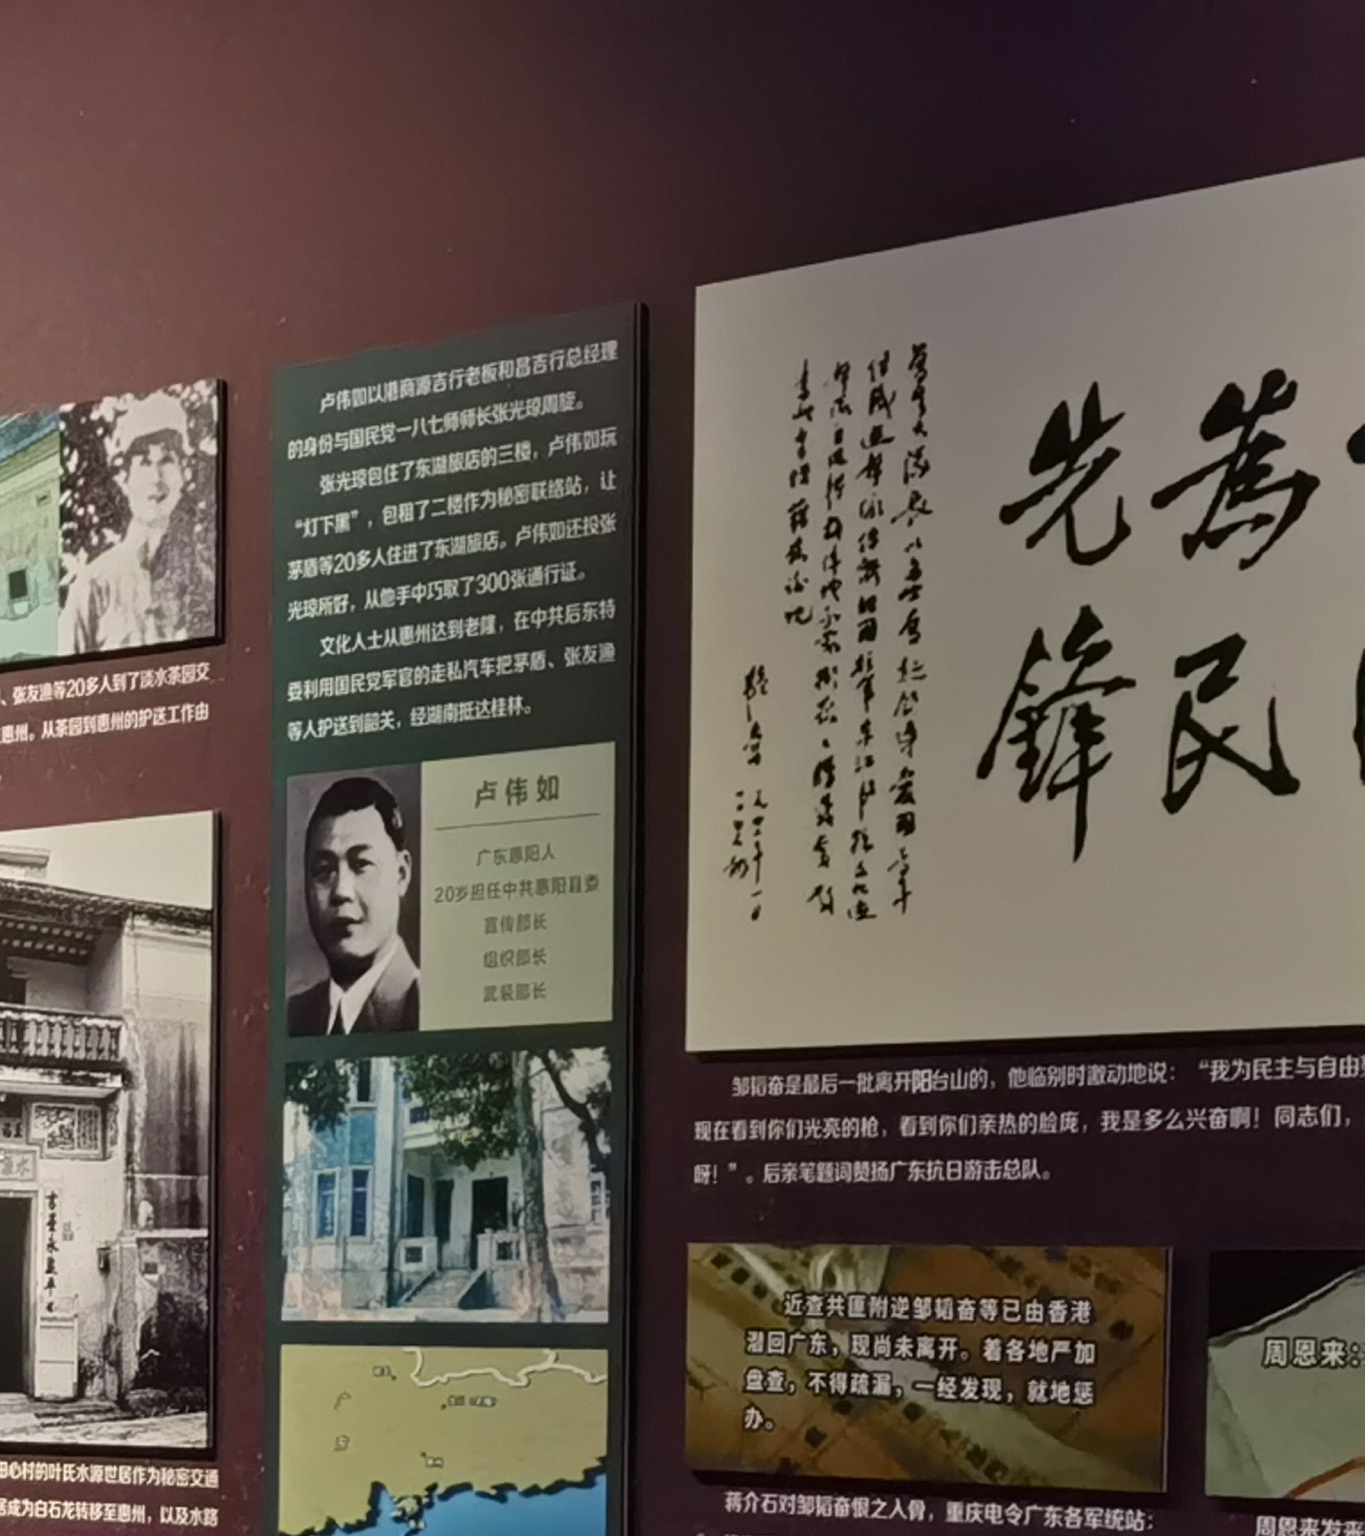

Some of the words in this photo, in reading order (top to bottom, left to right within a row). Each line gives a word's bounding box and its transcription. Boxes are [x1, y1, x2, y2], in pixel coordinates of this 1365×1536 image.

[473, 774, 561, 809] 卢伟如
[476, 842, 555, 867] 广东惠阳人
[483, 912, 548, 935] 宣传部长
[482, 948, 548, 969] 组织部长
[482, 981, 547, 1004] 武装部长
[783, 1292, 1093, 1325] 近查共匪附逆邹韬奋等已由香港
[744, 1369, 1094, 1406] 盘查，不得疏漏，一经发现，就地惩
